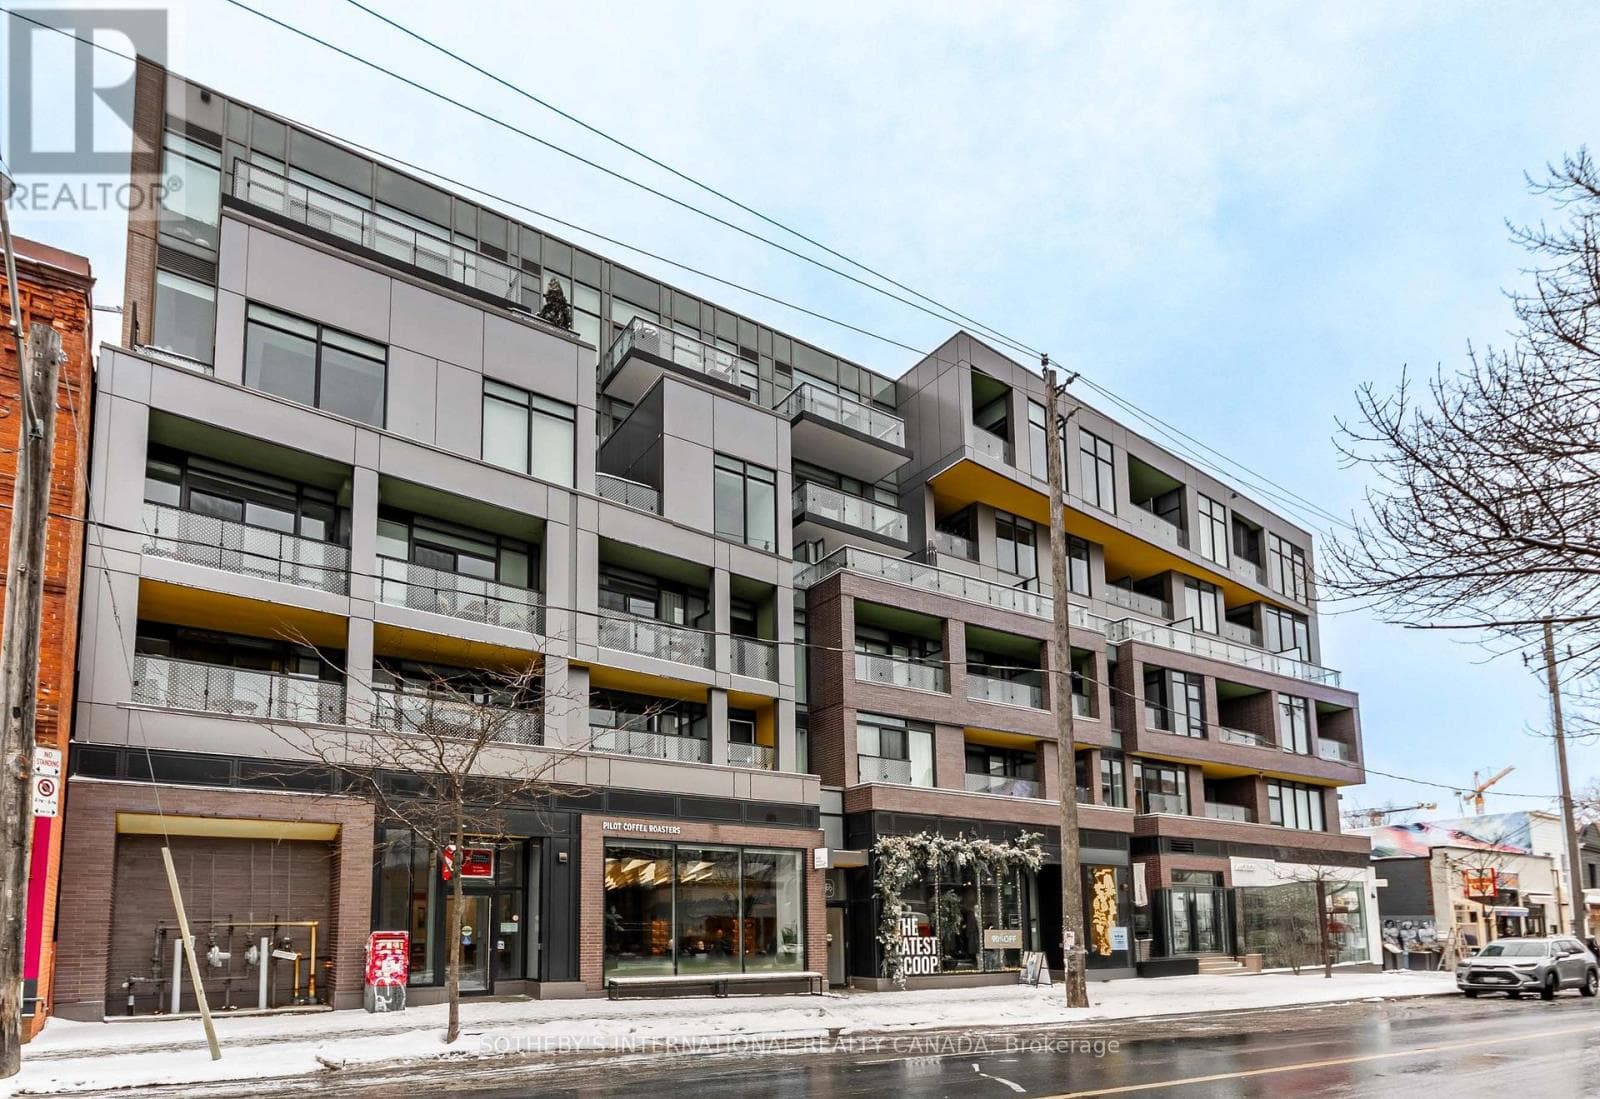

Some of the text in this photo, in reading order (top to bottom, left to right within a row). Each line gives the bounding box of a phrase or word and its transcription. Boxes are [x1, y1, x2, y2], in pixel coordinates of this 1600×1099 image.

[37, 758, 59, 767] STANDING
[602, 821, 681, 834] PILOT COFFEE ROASTERS
